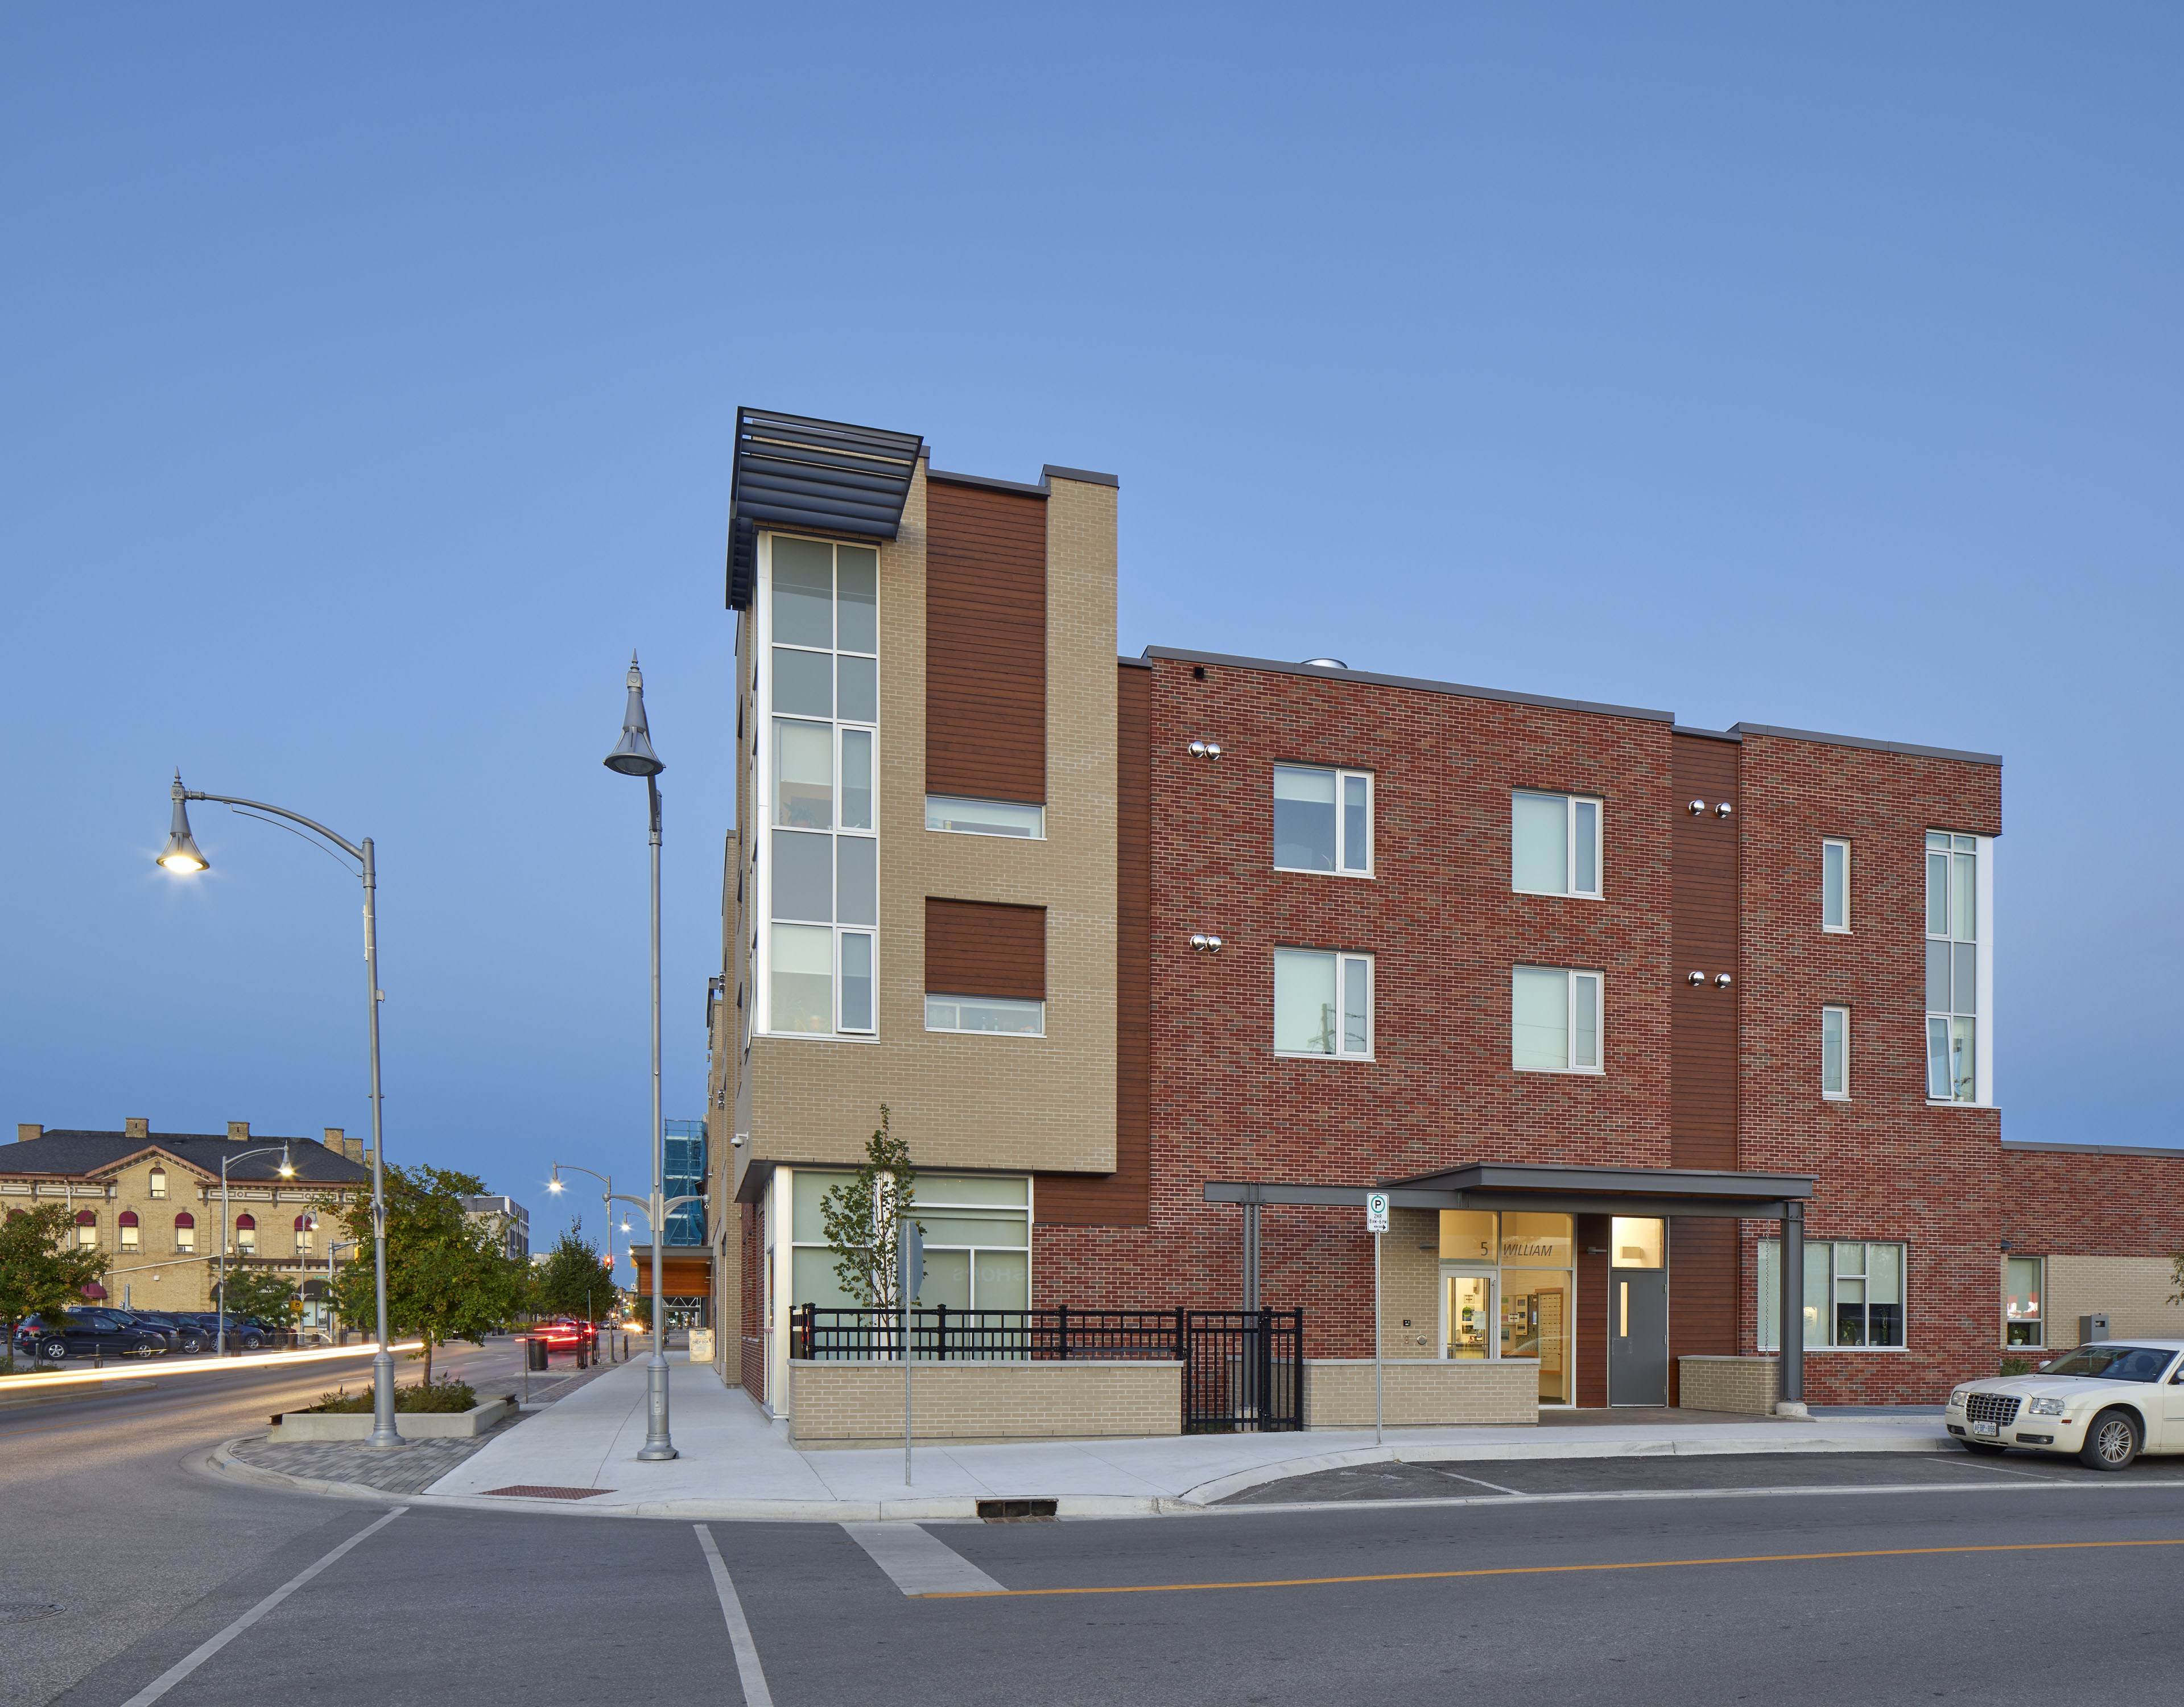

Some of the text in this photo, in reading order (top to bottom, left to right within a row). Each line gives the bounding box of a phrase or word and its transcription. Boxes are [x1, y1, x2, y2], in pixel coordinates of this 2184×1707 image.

[1375, 1200, 1381, 1209] P
[1481, 1242, 1553, 1256] 5 WILLIAM
